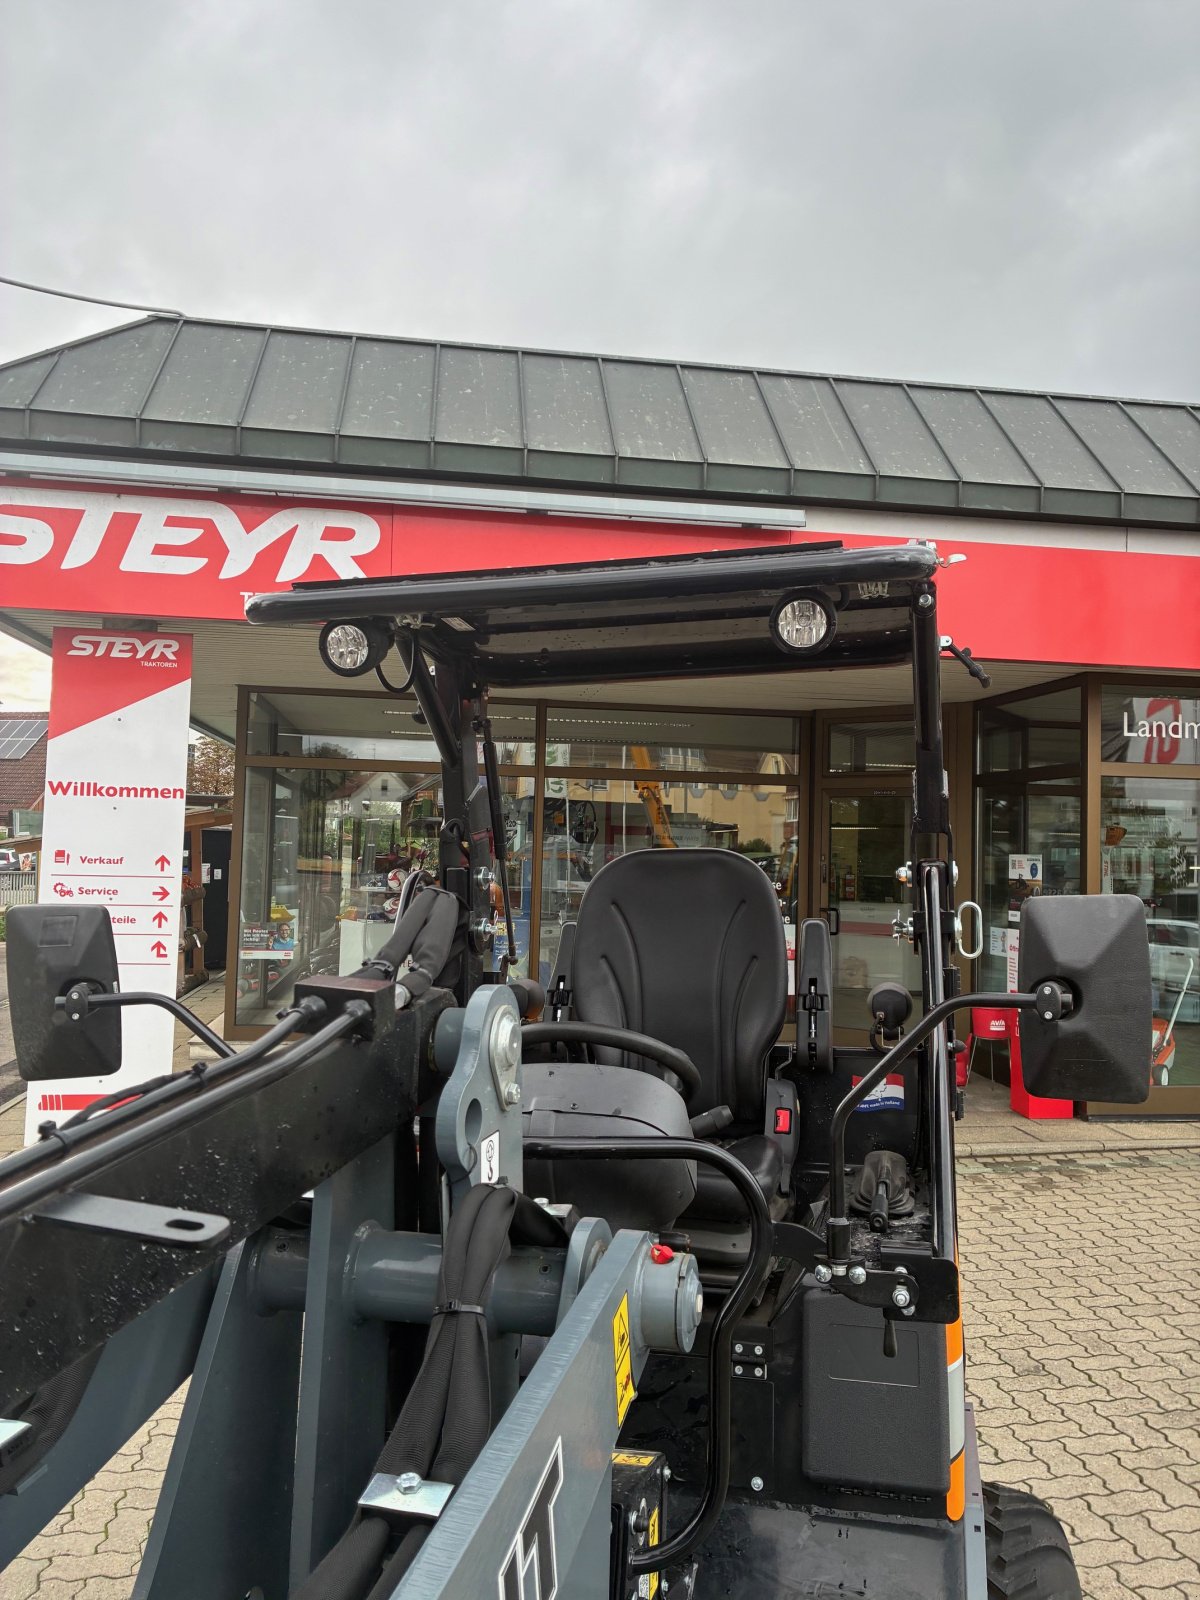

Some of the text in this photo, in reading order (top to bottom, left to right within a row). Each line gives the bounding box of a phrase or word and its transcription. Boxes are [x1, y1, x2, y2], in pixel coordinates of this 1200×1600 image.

[0, 486, 381, 583] STEYR
[66, 635, 180, 660] STEYR
[47, 780, 184, 799] Willkommen
[79, 855, 124, 865] Verkauf
[77, 886, 119, 896] Service
[111, 915, 137, 924] teile
